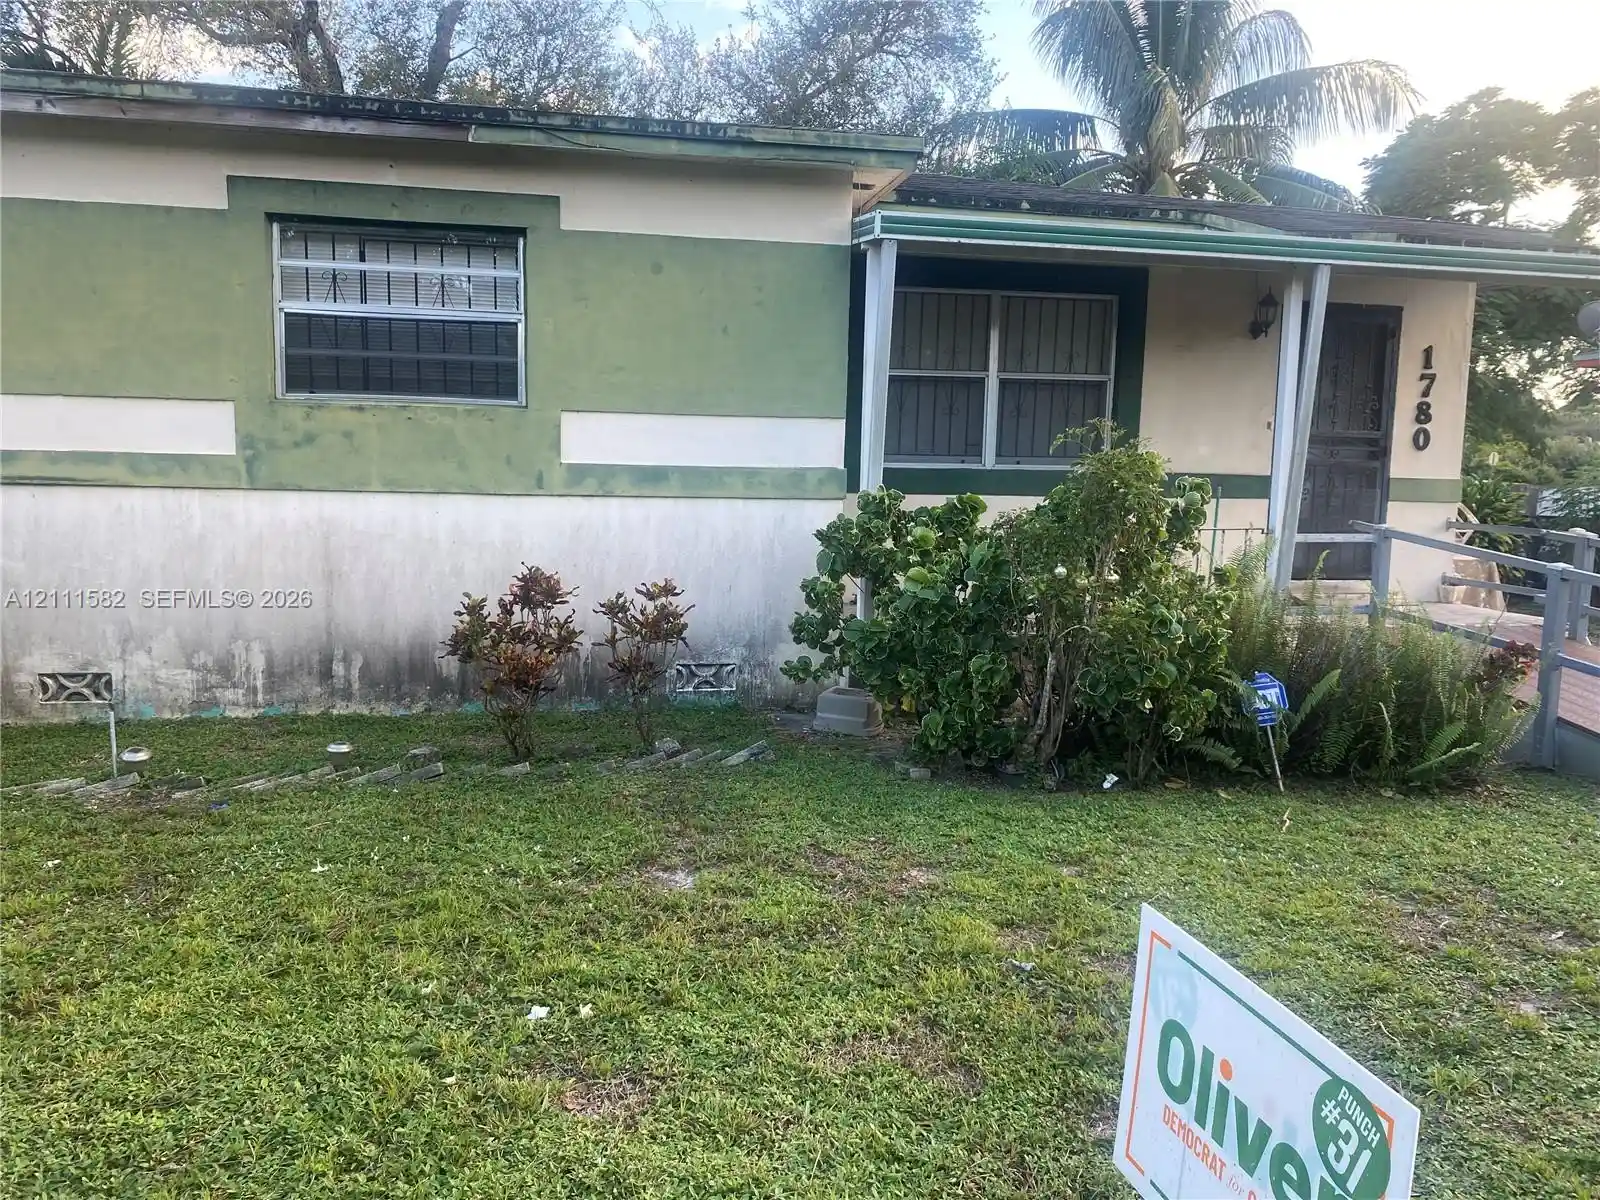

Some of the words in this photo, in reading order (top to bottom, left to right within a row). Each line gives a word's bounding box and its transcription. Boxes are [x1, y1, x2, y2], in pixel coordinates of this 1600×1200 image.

[1412, 345, 1437, 451] 1780
[1163, 1104, 1226, 1182] DEMOCRAT
[1320, 1099, 1372, 1194] #31
[1338, 1085, 1380, 1148] PUNCH
